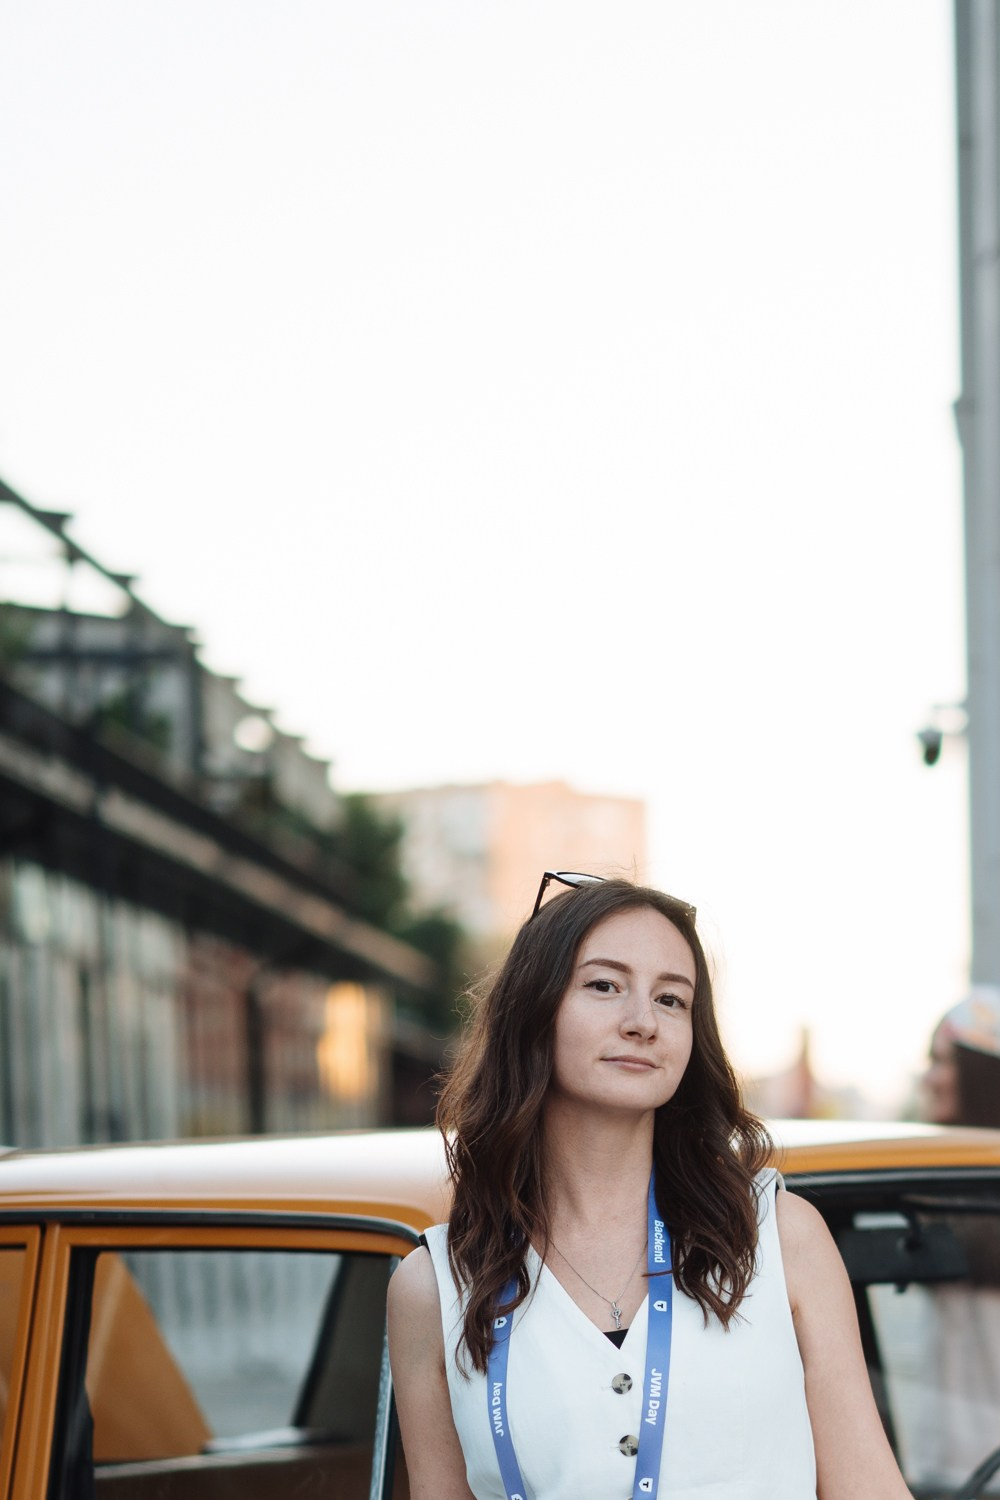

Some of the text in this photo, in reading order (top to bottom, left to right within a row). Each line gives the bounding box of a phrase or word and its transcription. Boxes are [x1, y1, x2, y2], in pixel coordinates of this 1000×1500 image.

[654, 1219, 666, 1263] Backend
[492, 1382, 504, 1437] JVM Day
[645, 1368, 663, 1426] JVM Day
